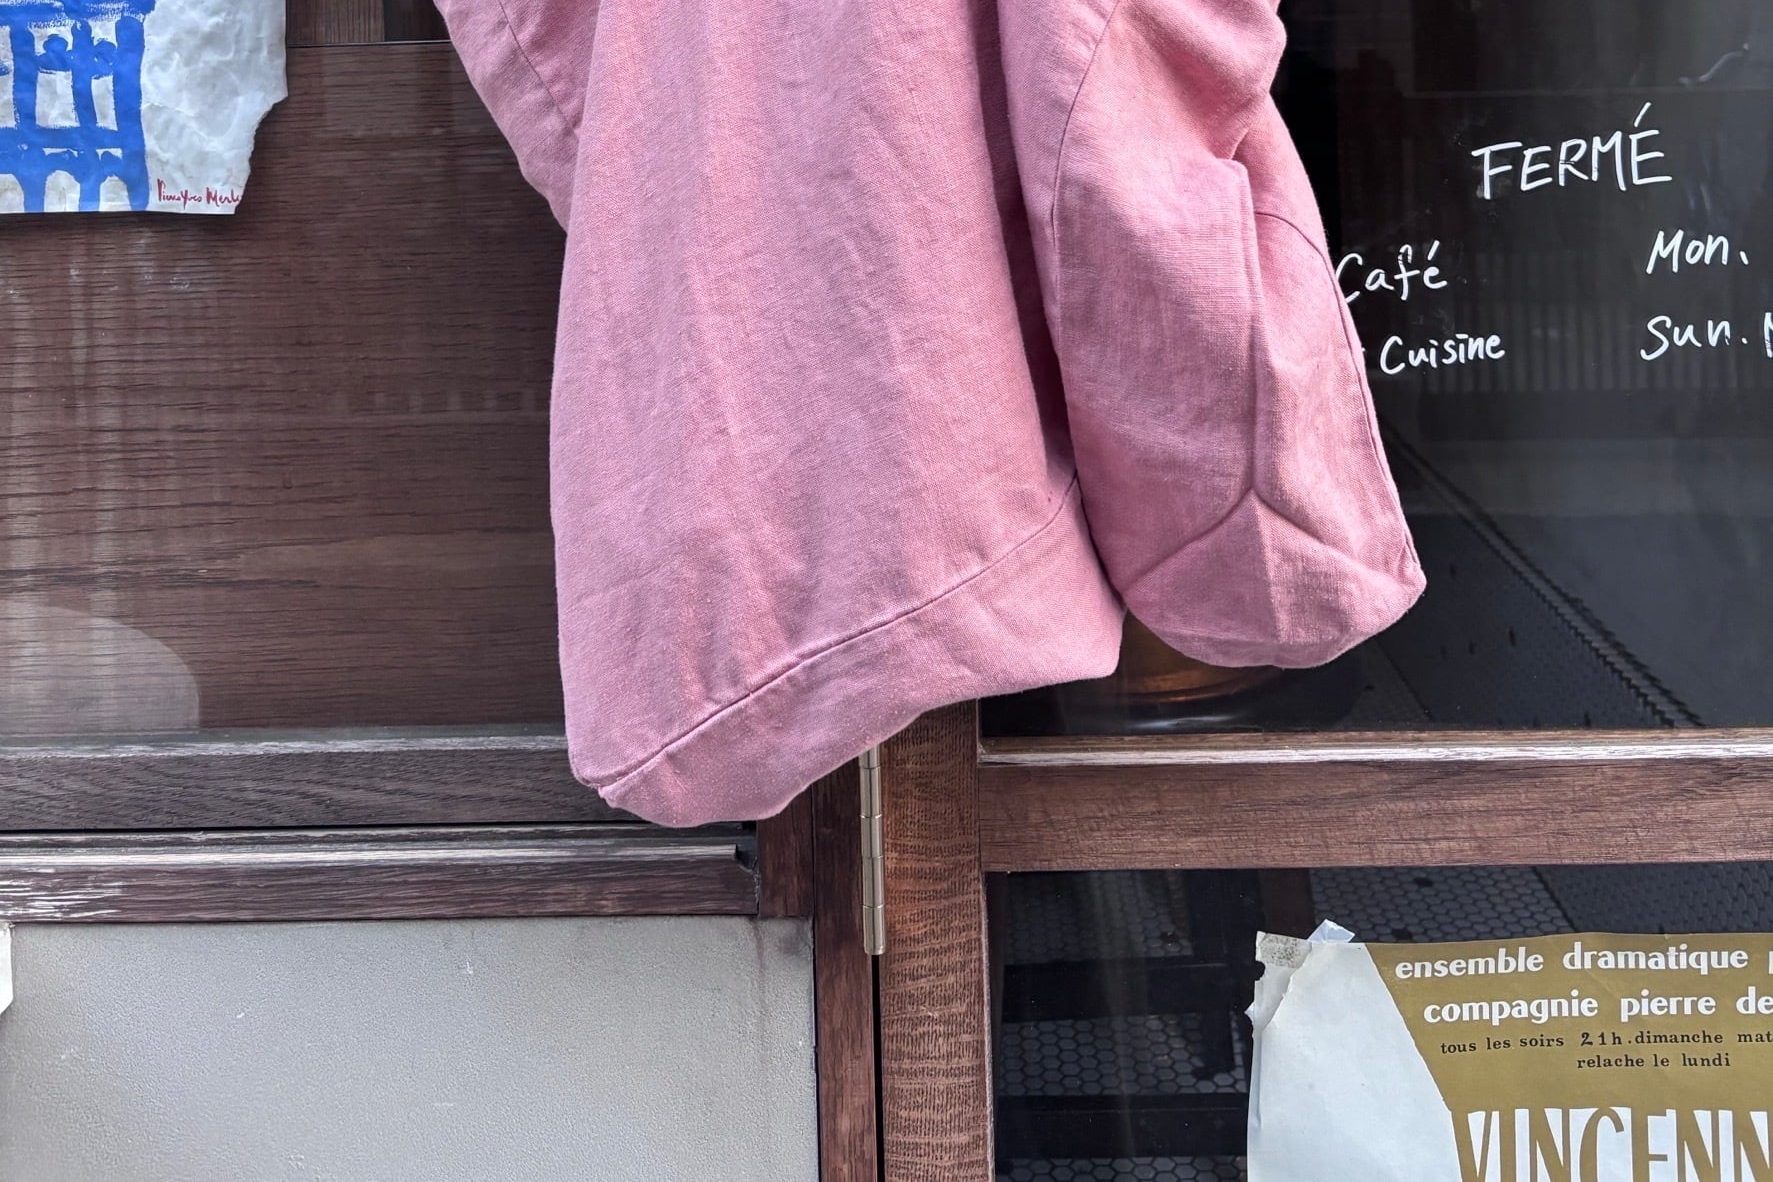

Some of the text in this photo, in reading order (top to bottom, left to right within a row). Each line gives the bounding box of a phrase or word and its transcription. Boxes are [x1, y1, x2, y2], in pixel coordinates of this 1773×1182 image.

[1471, 101, 1673, 200] FERMÉ
[1335, 240, 1448, 304] Café
[1646, 229, 1749, 275] Mon.
[1380, 334, 1506, 375] Cuisine
[1640, 315, 1749, 361] Sun.
[1395, 946, 1544, 979] ensemble
[1563, 941, 1749, 975] dramatique
[1423, 989, 1599, 1026] compagnie
[1620, 989, 1717, 1023] pierre
[1440, 1041, 1477, 1054] tous
[1486, 1037, 1511, 1050] les
[1519, 1034, 1564, 1047] soirs
[1577, 1053, 1731, 1069] relache le lundi
